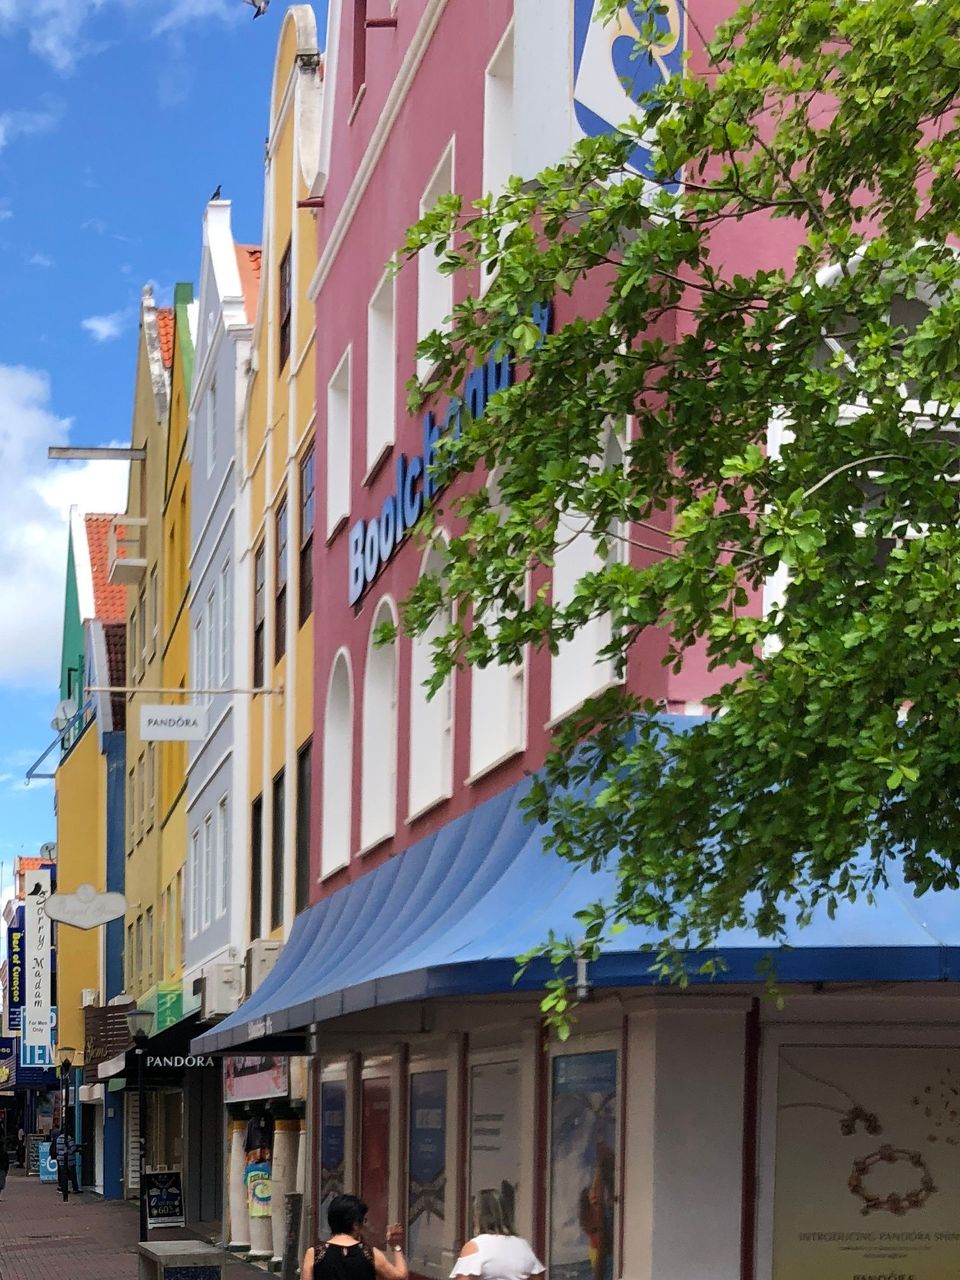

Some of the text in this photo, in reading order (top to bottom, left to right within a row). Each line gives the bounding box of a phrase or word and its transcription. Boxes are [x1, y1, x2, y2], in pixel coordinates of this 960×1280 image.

[32, 957, 45, 1008] Madam
[146, 1056, 215, 1068] PANDORA
[879, 1231, 931, 1242] PANDORA
